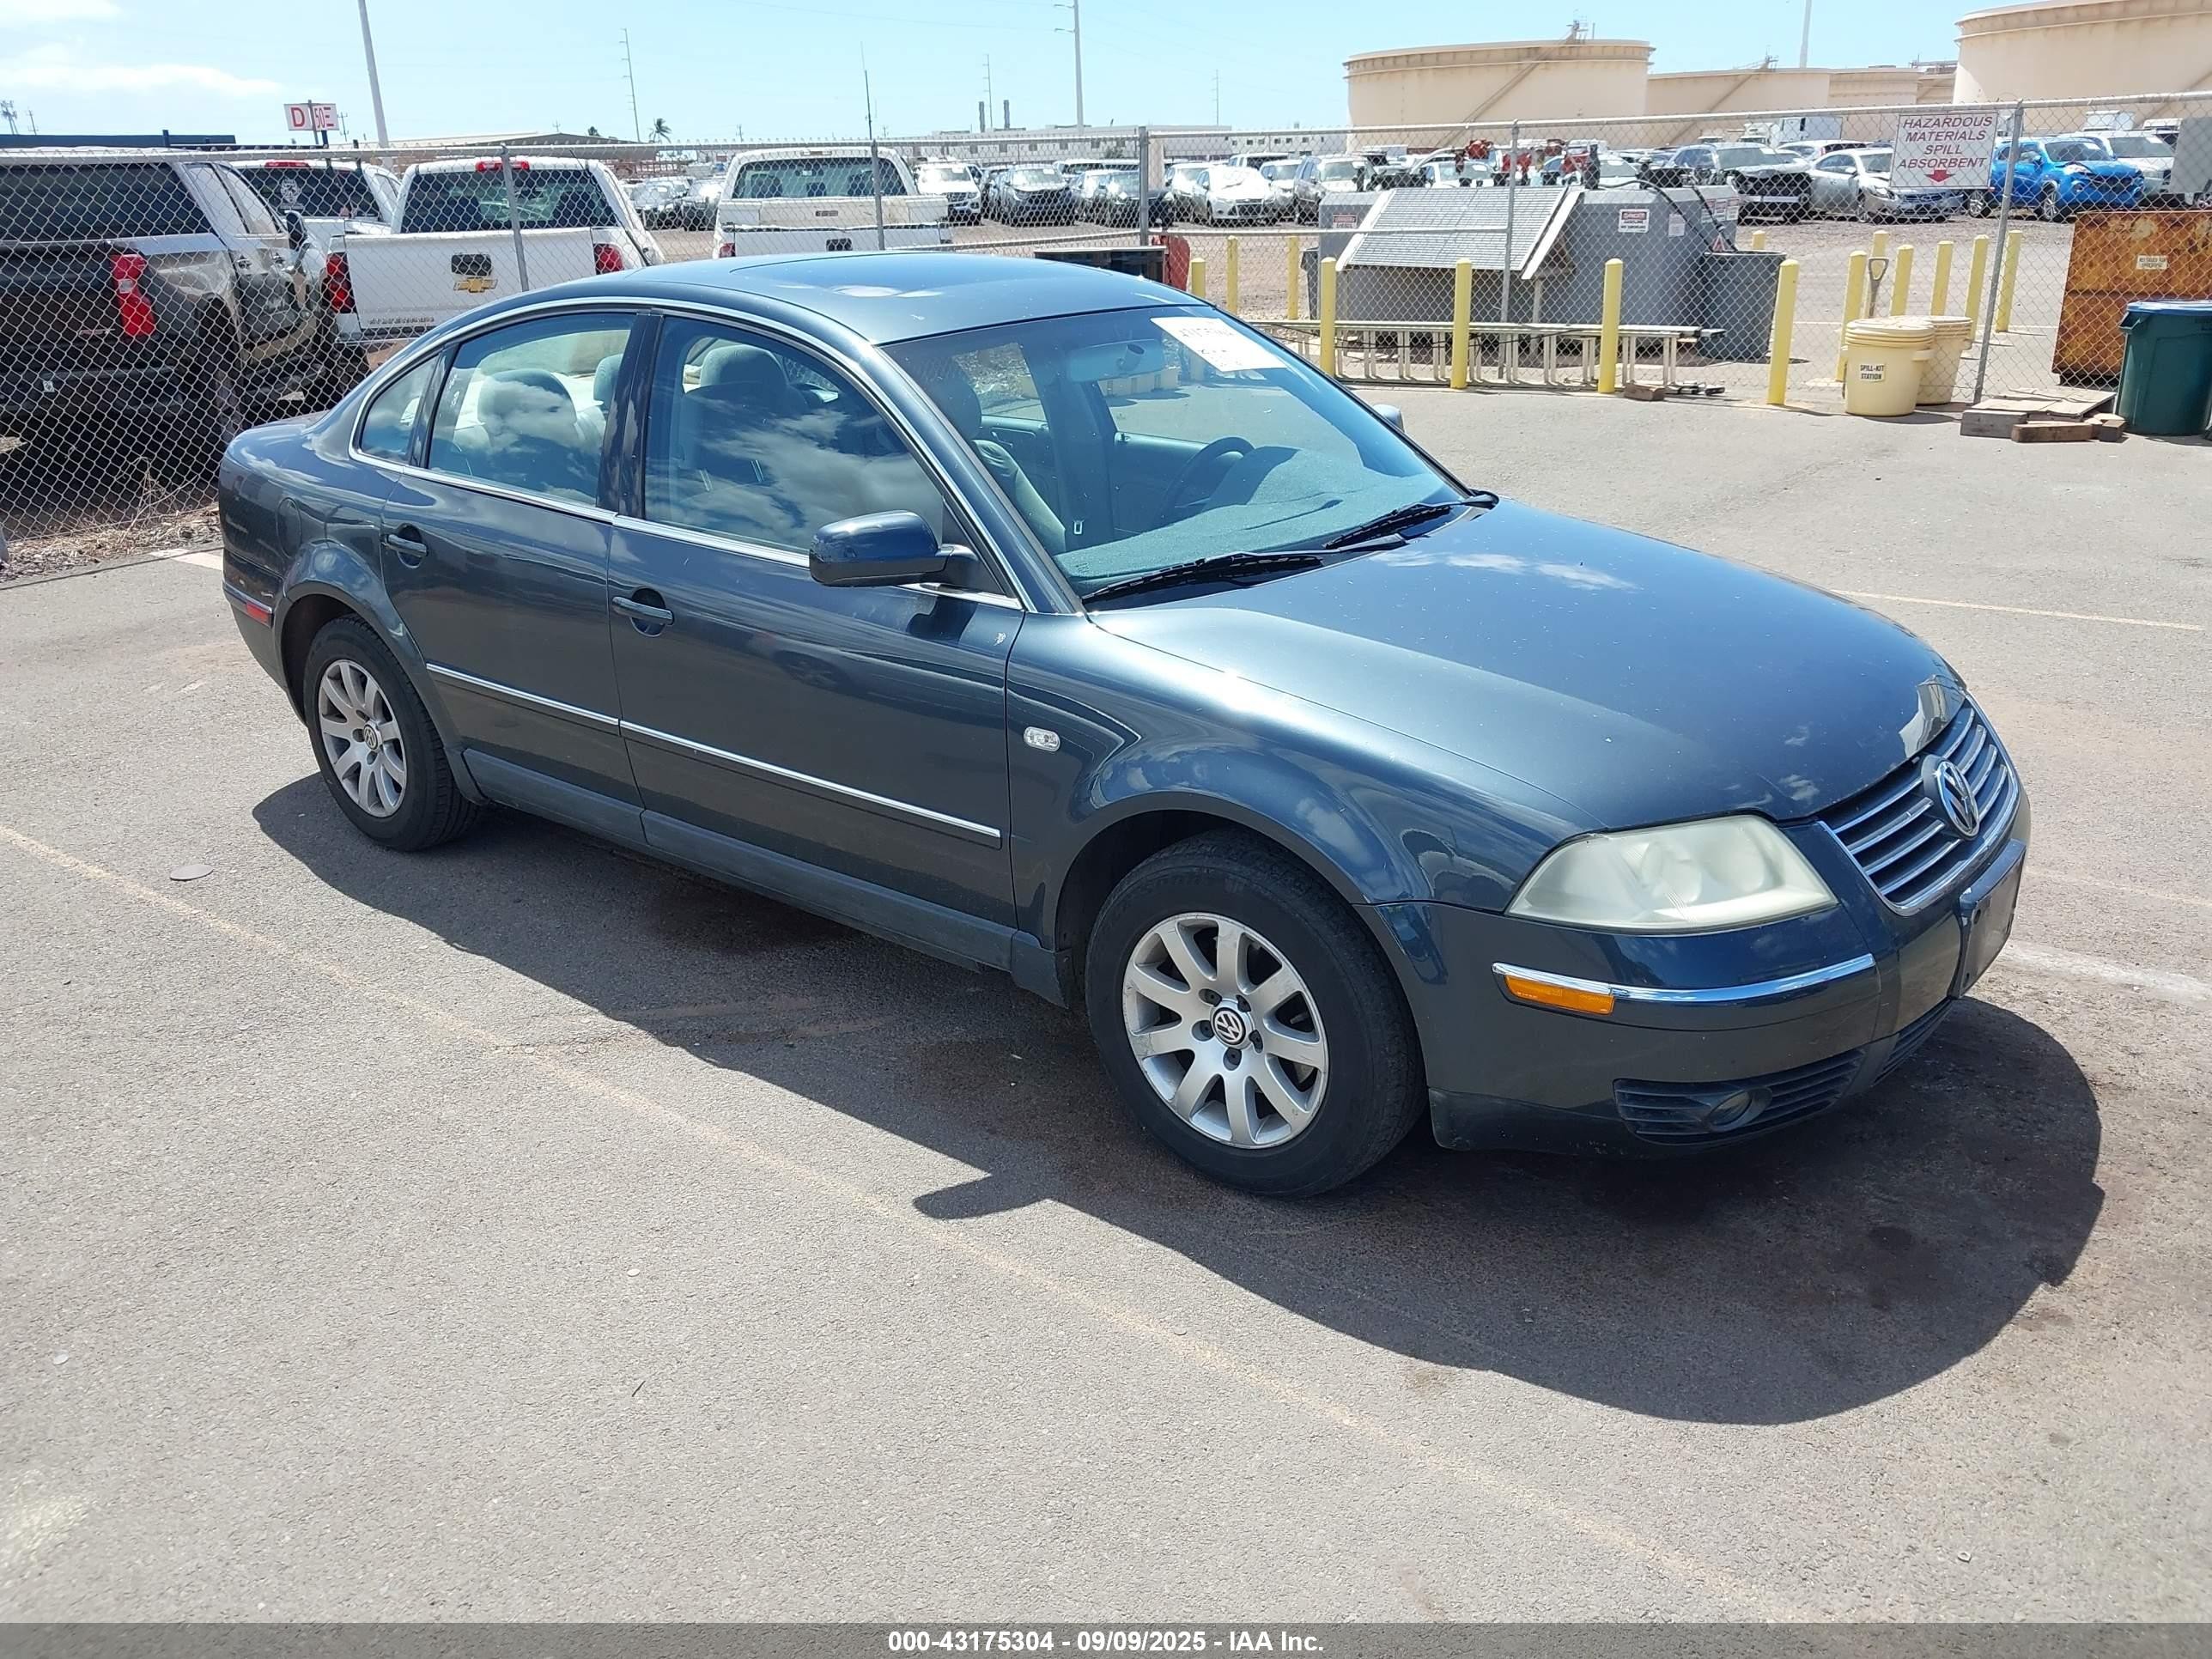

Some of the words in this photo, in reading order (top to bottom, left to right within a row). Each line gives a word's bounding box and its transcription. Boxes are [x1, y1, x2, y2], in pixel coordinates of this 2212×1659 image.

[1903, 117, 1993, 129] HAZARDOUS
[1905, 130, 1987, 143] MATERIALS
[1923, 144, 1963, 155] SPILL
[1897, 157, 1988, 169] ABSORBENT
